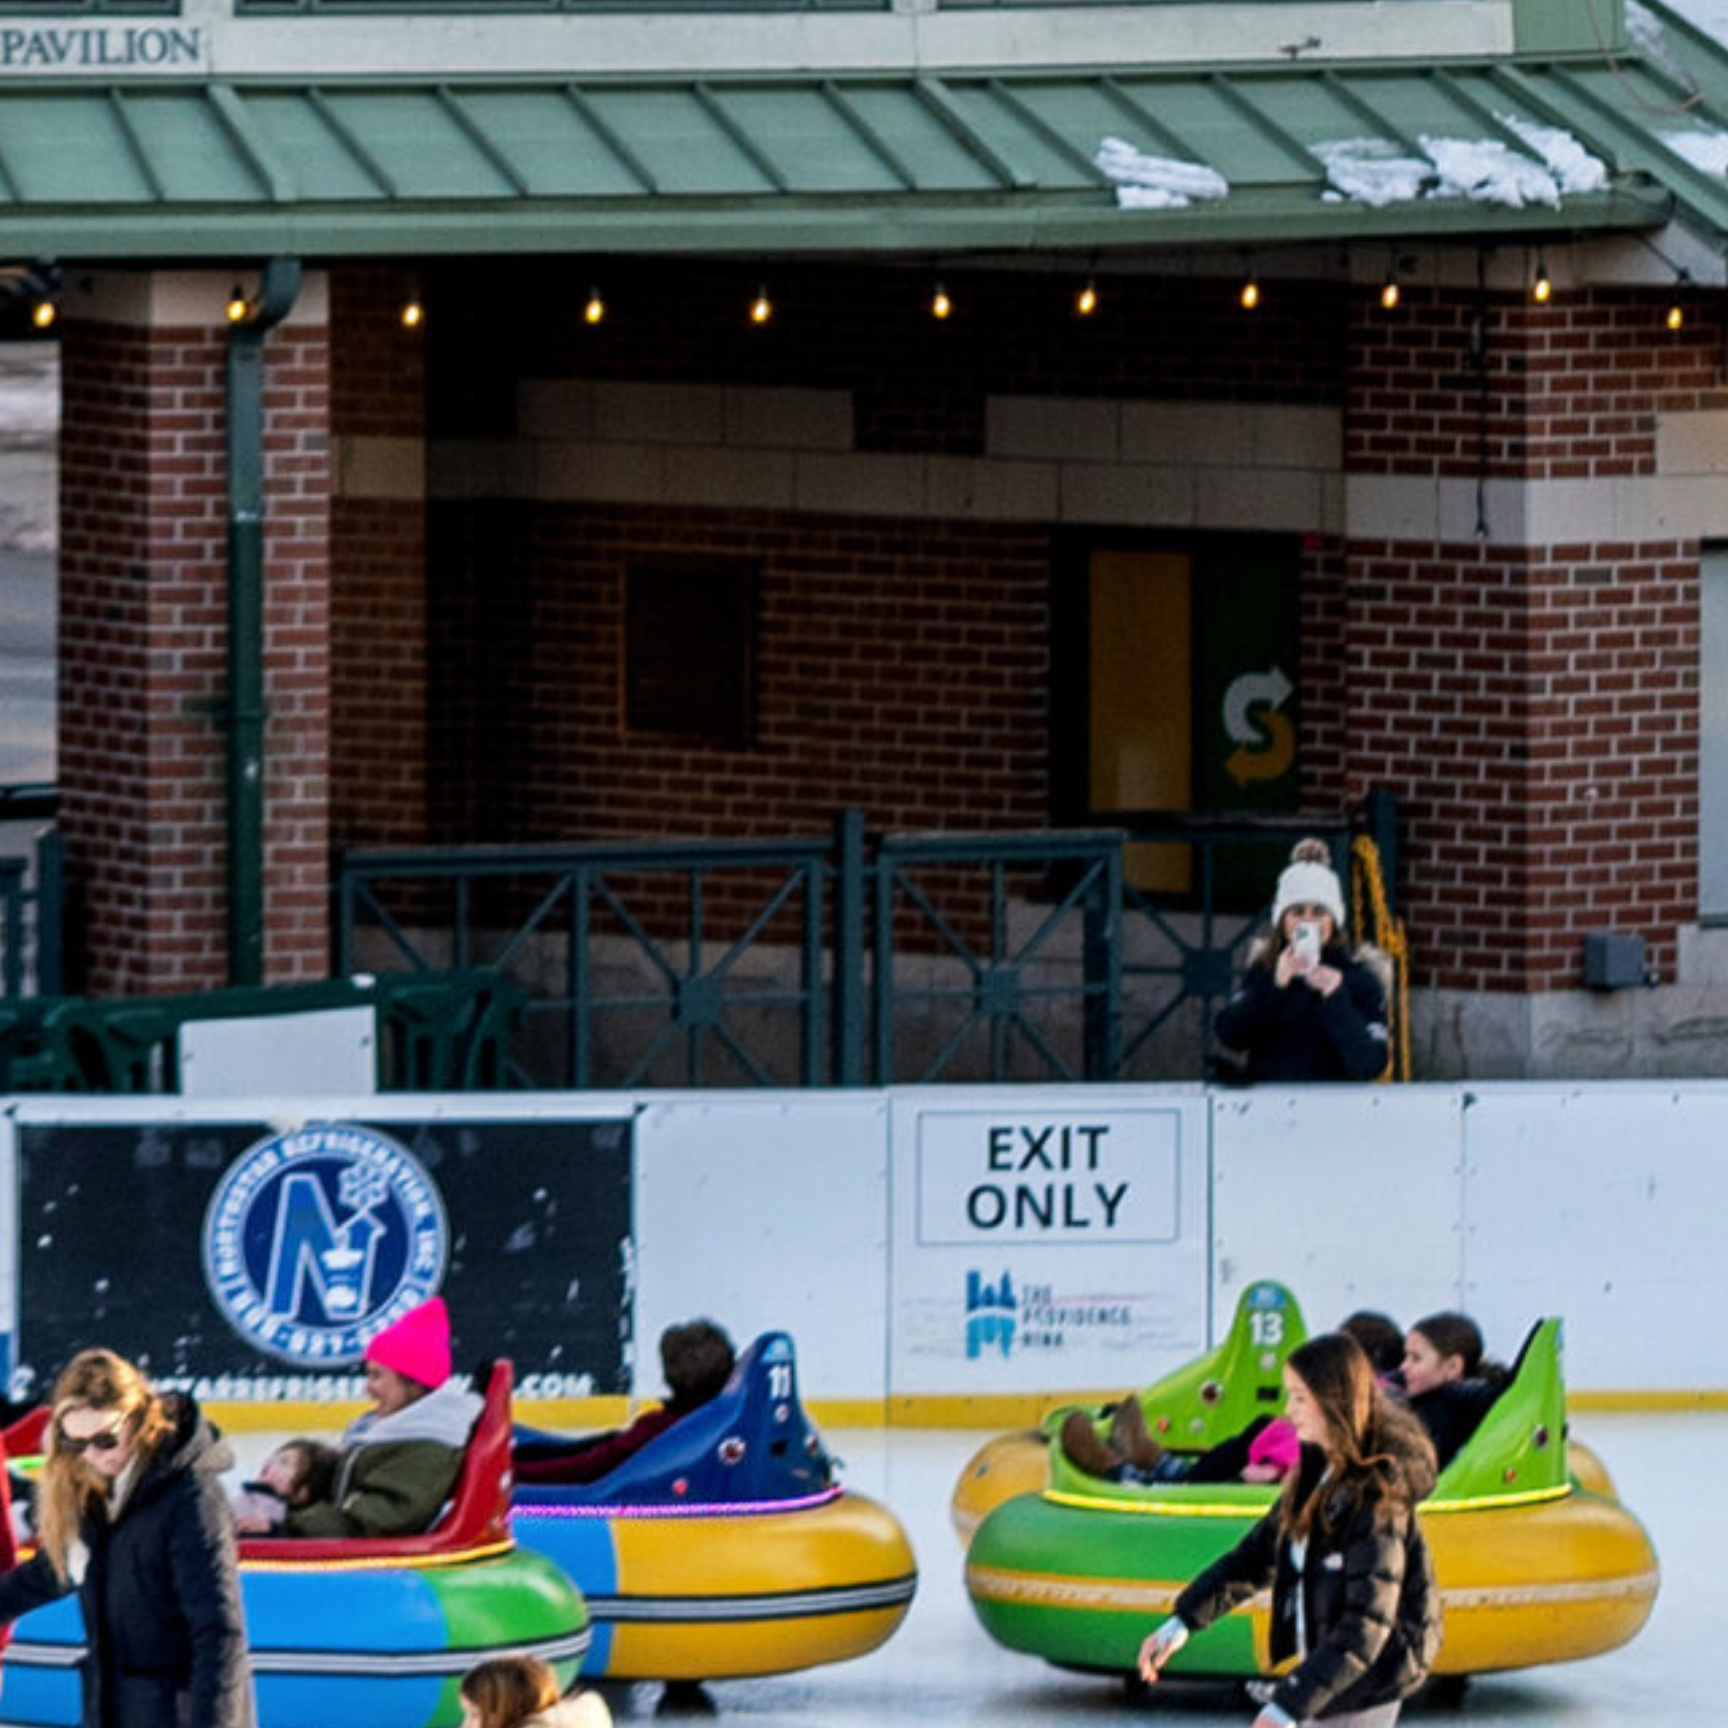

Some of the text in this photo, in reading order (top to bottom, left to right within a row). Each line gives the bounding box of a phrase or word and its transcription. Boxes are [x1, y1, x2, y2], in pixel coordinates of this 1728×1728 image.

[0, 28, 202, 64] PAVILION
[987, 1125, 1110, 1172] EXIT
[966, 1182, 1131, 1230] ONLY
[1250, 1311, 1284, 1346] 13
[768, 1365, 792, 1398] 11
